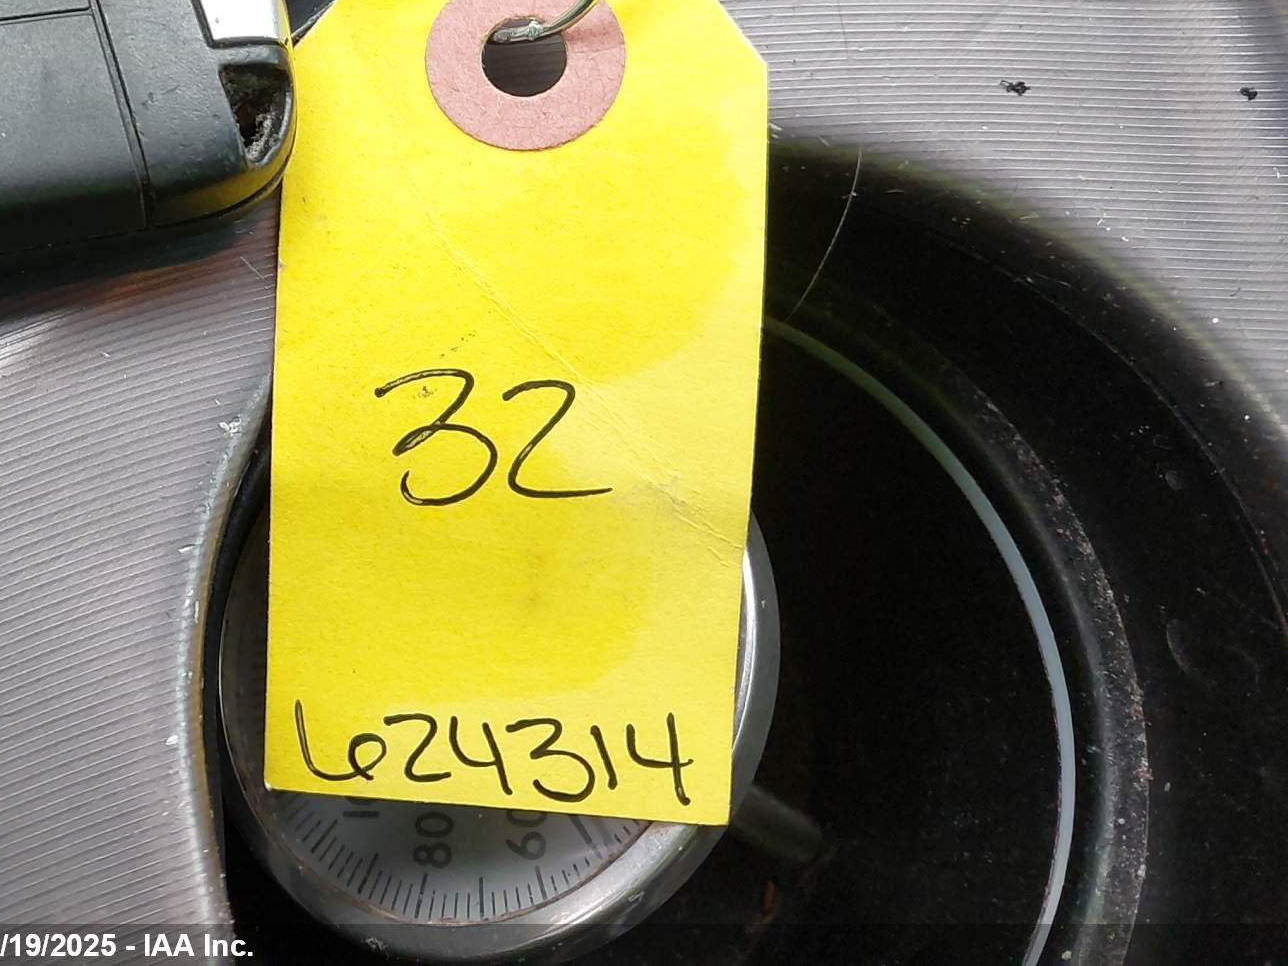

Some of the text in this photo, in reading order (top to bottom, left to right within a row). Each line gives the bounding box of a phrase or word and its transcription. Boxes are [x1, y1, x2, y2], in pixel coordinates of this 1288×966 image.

[375, 367, 613, 506] 32
[294, 699, 694, 806] 624314
[413, 811, 454, 868] 80
